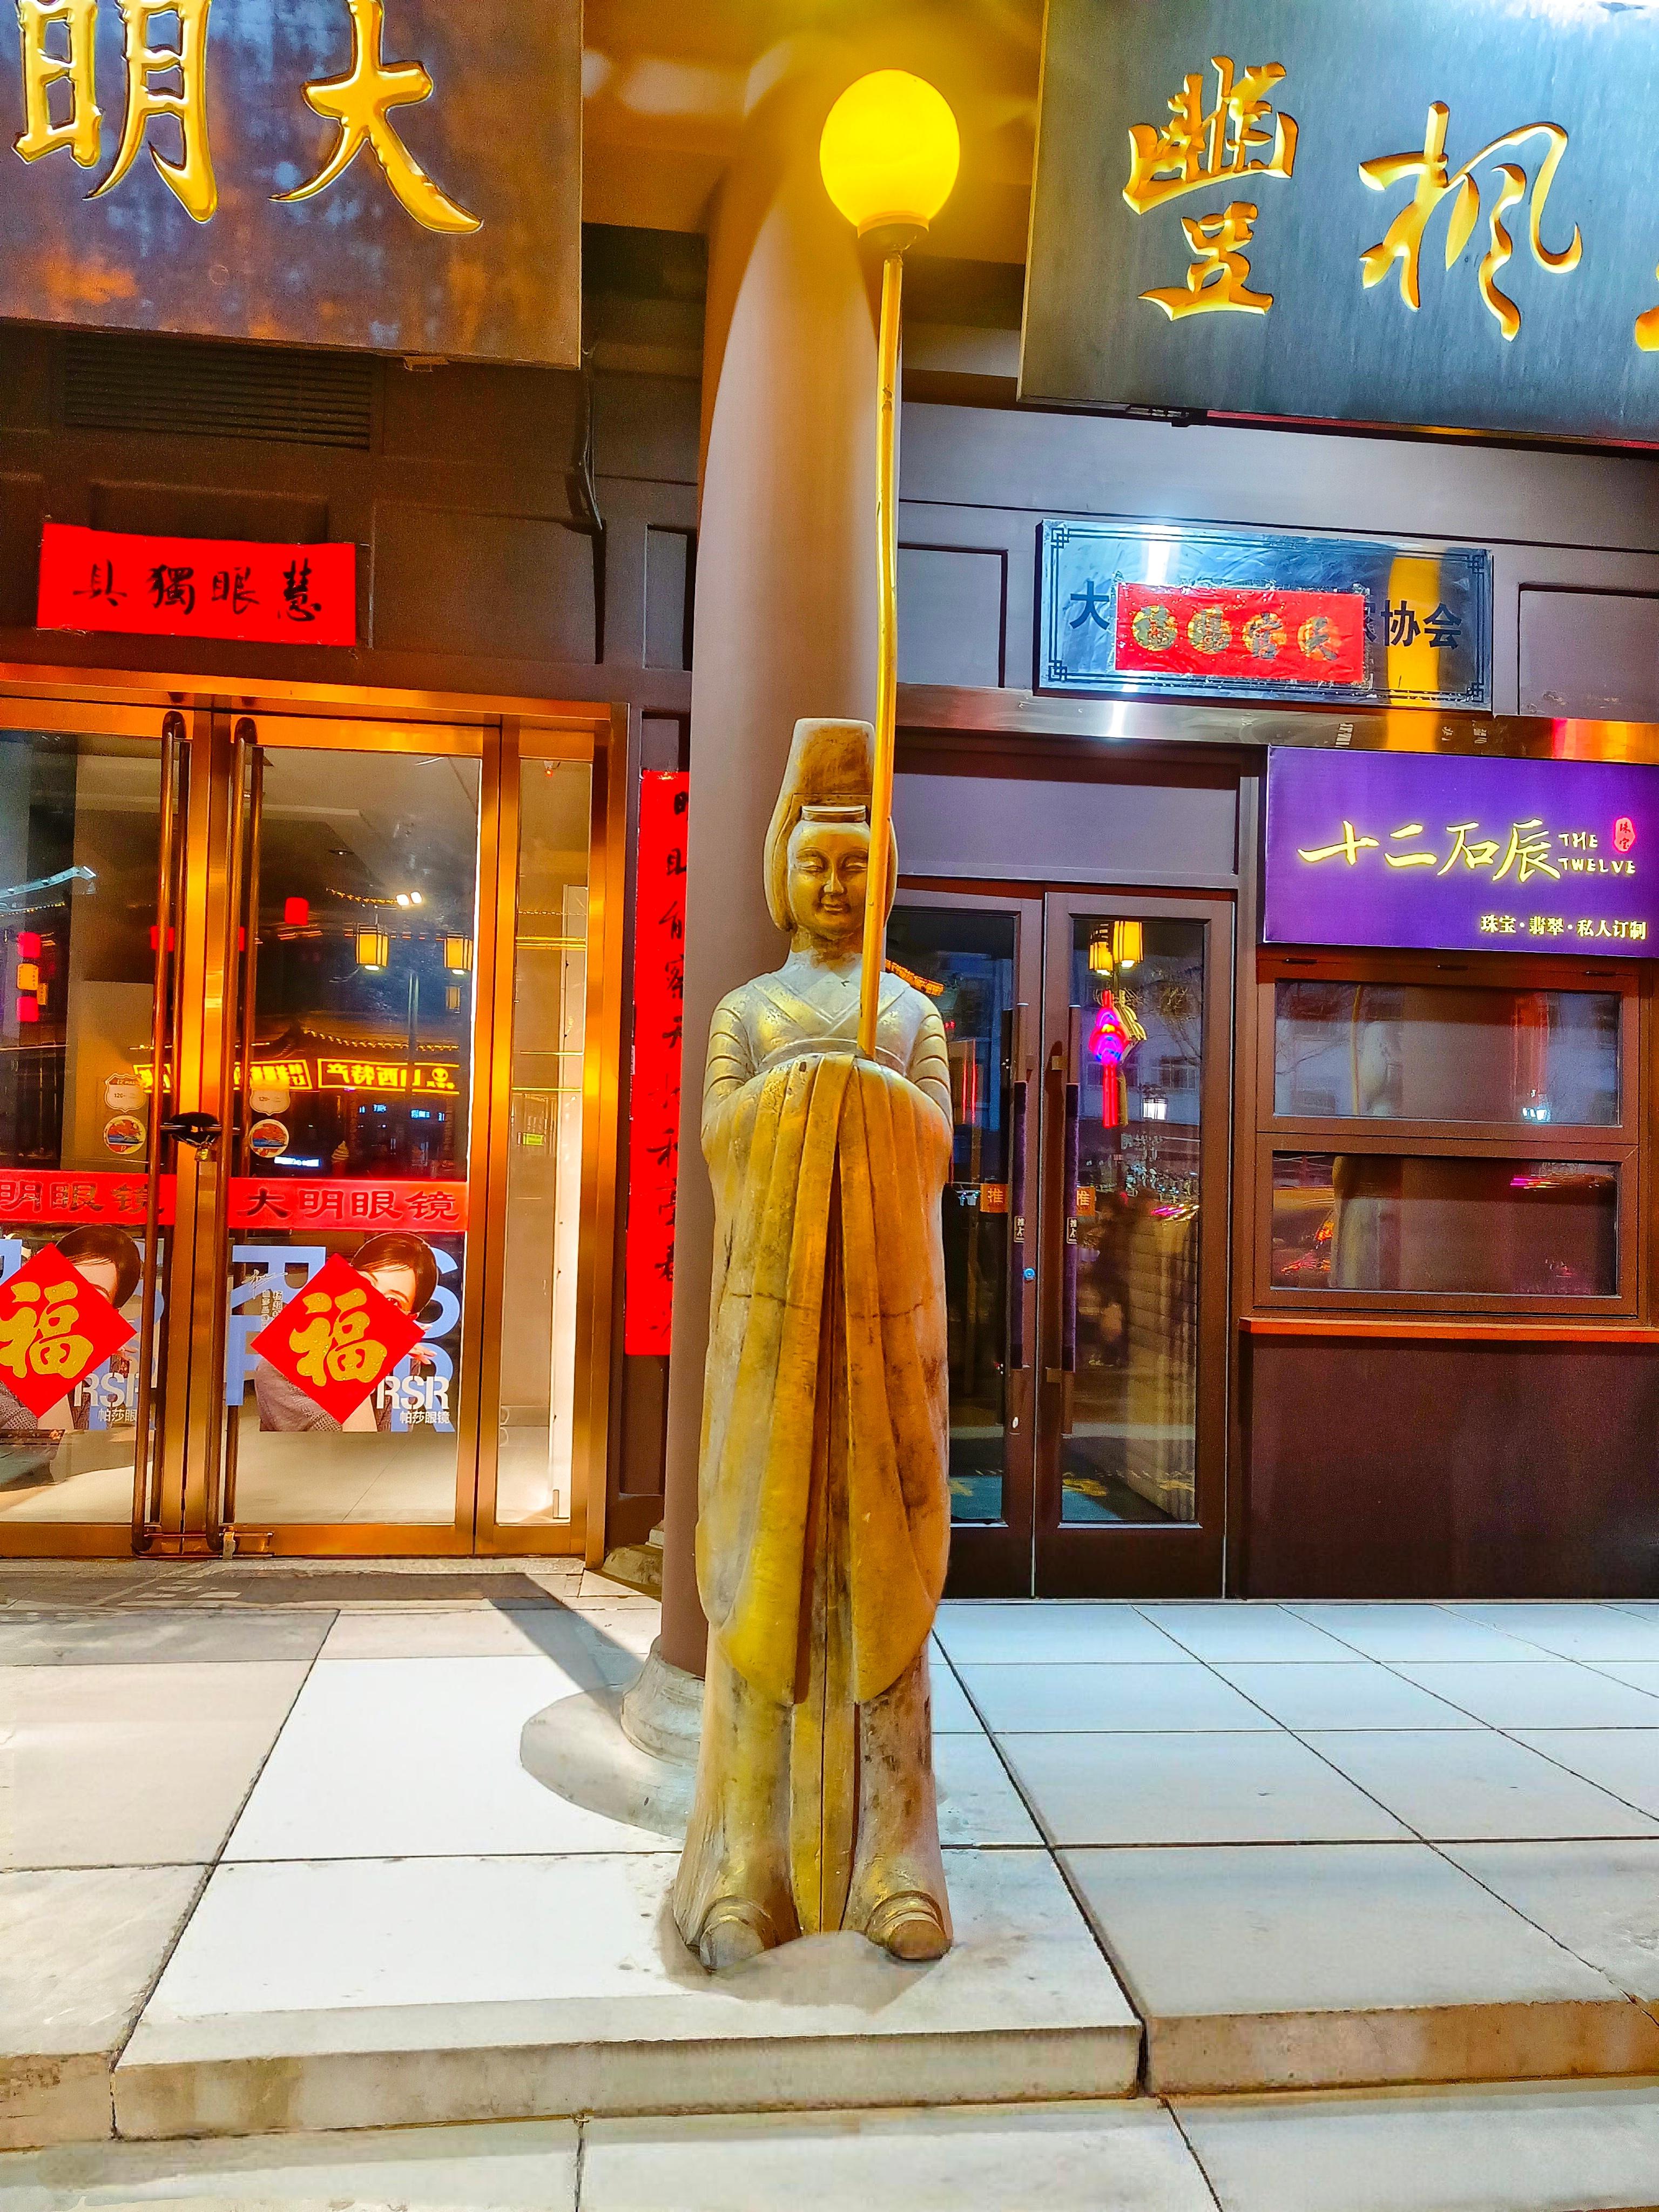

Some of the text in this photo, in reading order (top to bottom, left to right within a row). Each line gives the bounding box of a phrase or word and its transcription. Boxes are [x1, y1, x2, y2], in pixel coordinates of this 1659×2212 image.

[1297, 818, 1561, 883] 十二石辰
[1558, 831, 1599, 851] THE
[1557, 857, 1636, 874] TWELVE
[237, 1188, 460, 1221] 大明眼镜
[987, 1187, 1003, 1204] 推
[0, 1280, 94, 1379] 福
[289, 1287, 388, 1387] 福
[399, 1410, 450, 1424] 帕莎眼镜
